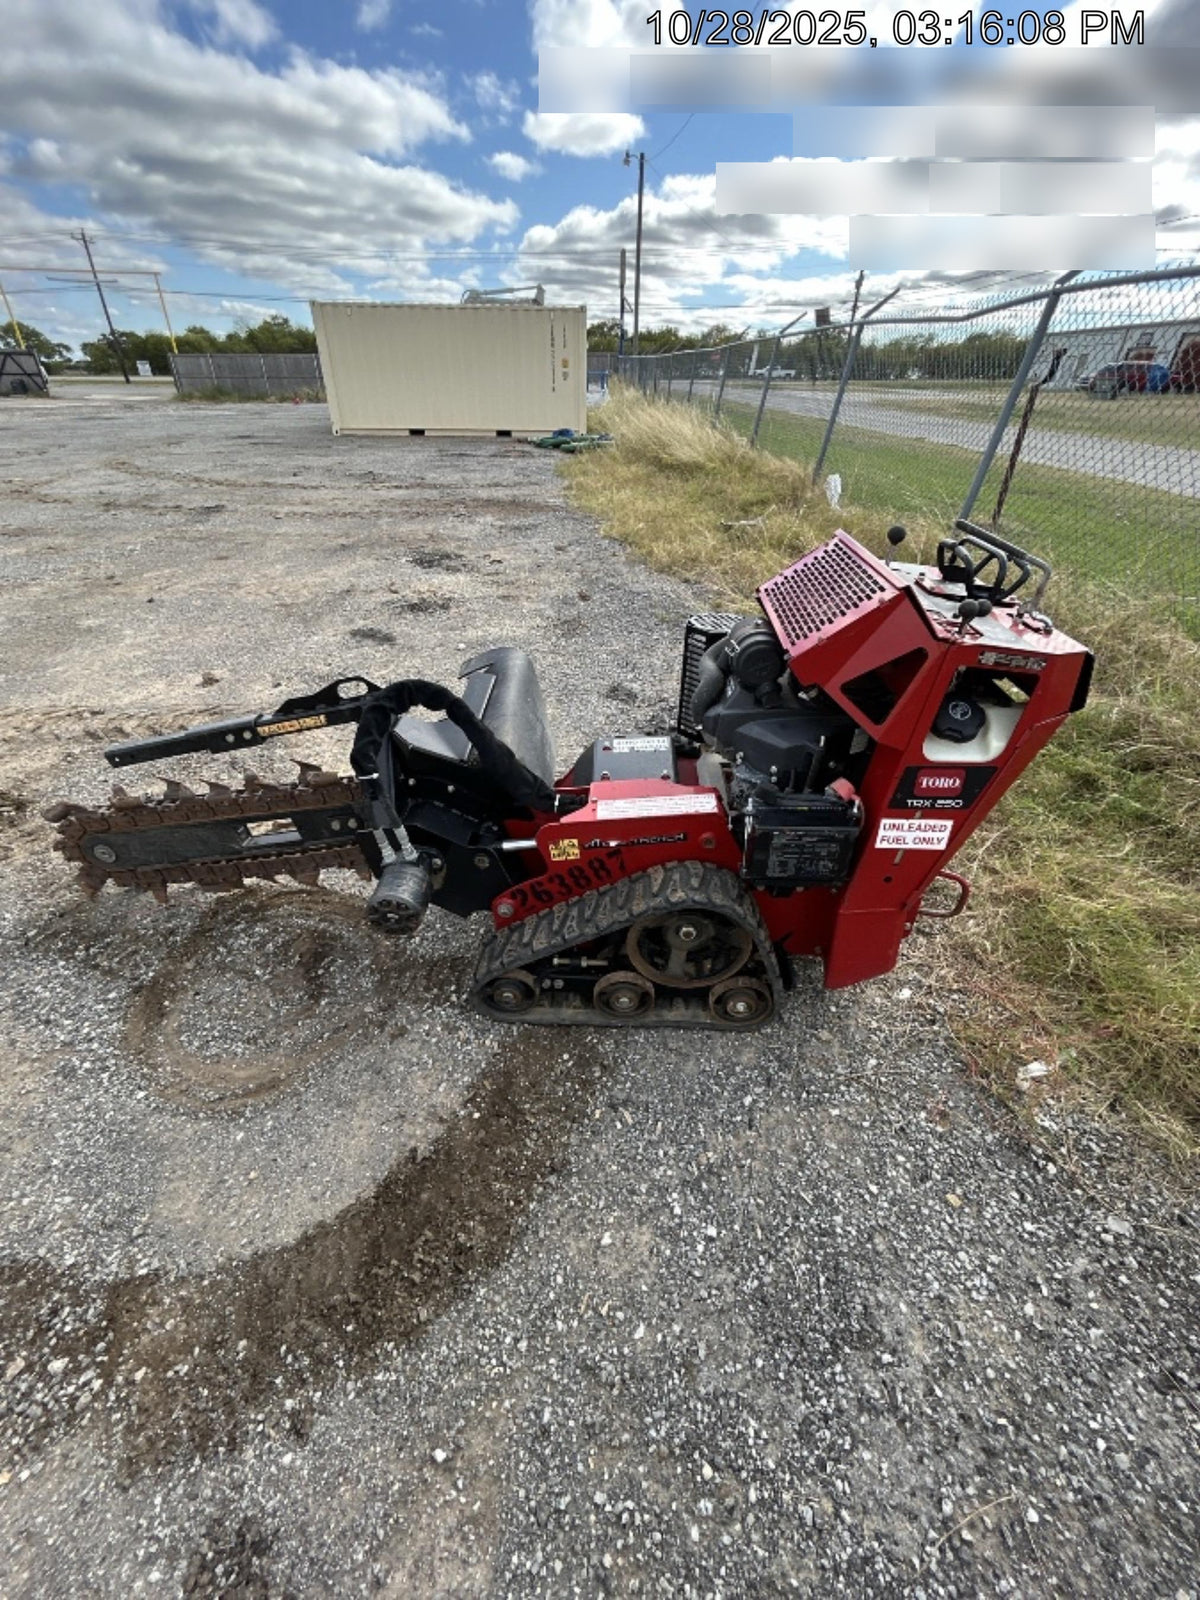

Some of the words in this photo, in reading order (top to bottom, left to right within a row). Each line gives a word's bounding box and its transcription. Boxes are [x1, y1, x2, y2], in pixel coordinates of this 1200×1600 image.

[919, 776, 960, 789] TORO
[906, 799, 932, 808] TRX
[883, 822, 948, 833] UNLEADED
[880, 835, 909, 845] FUEL
[911, 836, 944, 846] ONLY
